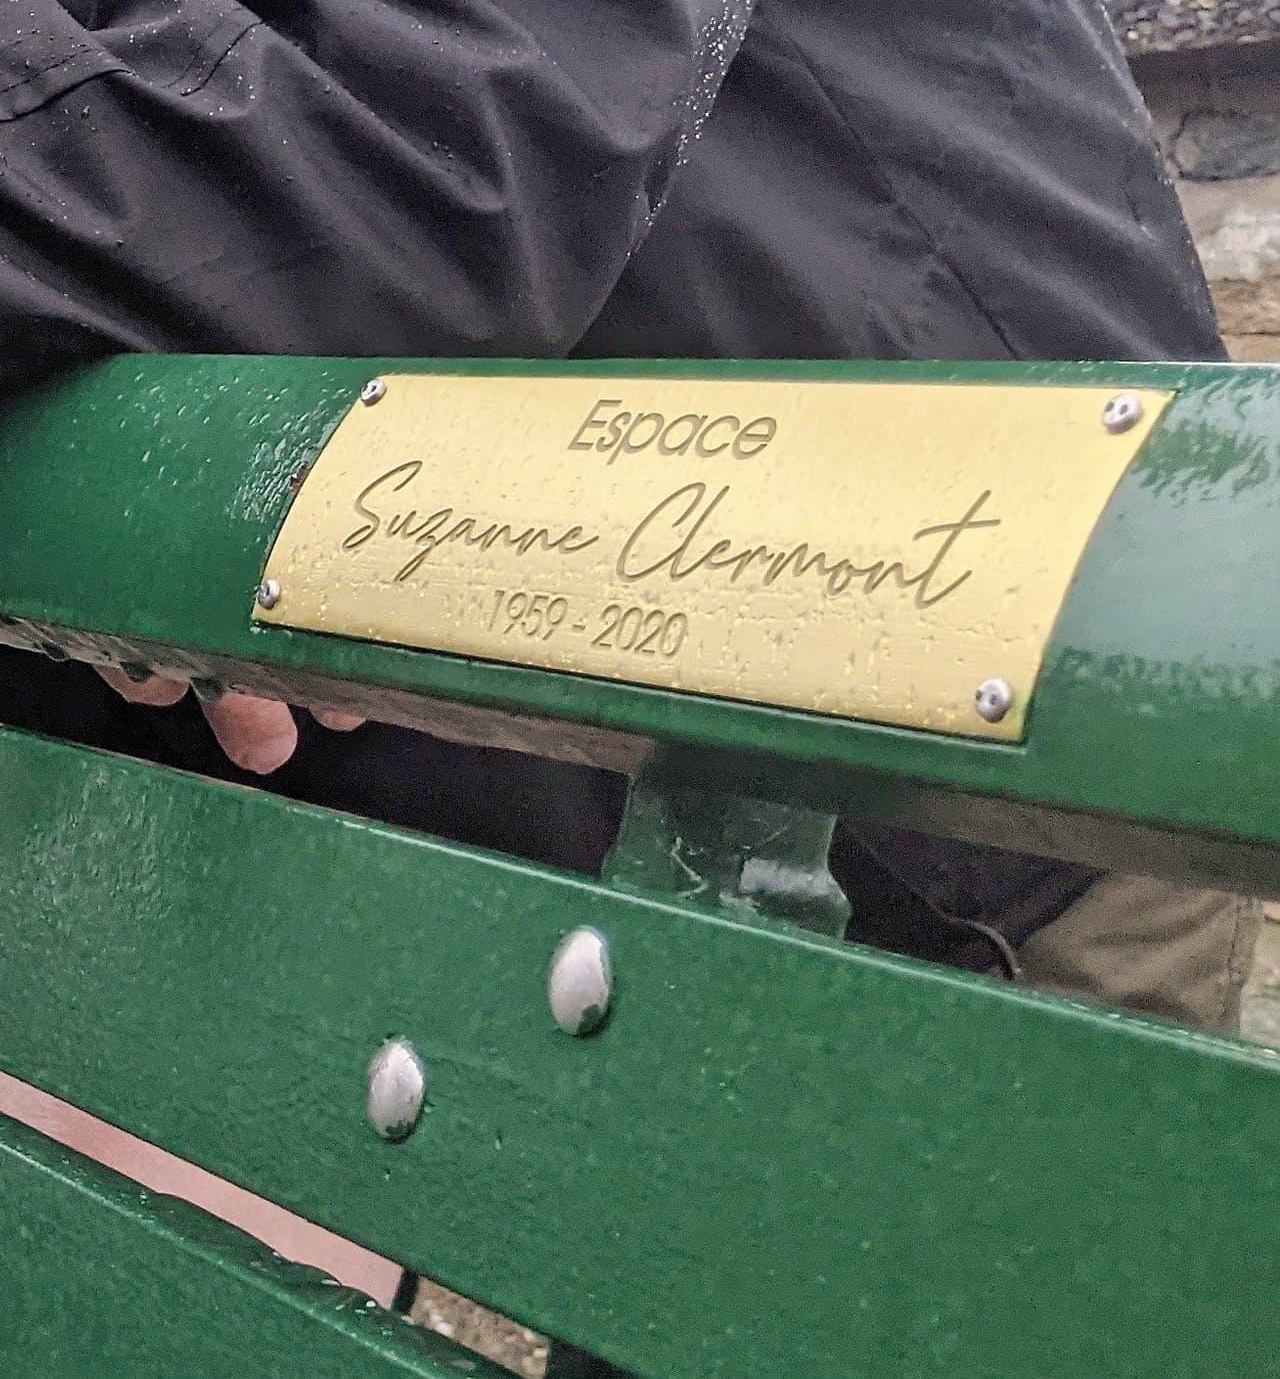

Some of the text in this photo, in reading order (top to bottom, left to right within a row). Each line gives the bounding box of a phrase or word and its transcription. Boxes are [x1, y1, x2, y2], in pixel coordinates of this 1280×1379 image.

[569, 399, 777, 465] Espace
[342, 459, 1002, 610] Suzanne Clermont
[485, 589, 569, 642] 1959
[590, 603, 690, 658] 2020
